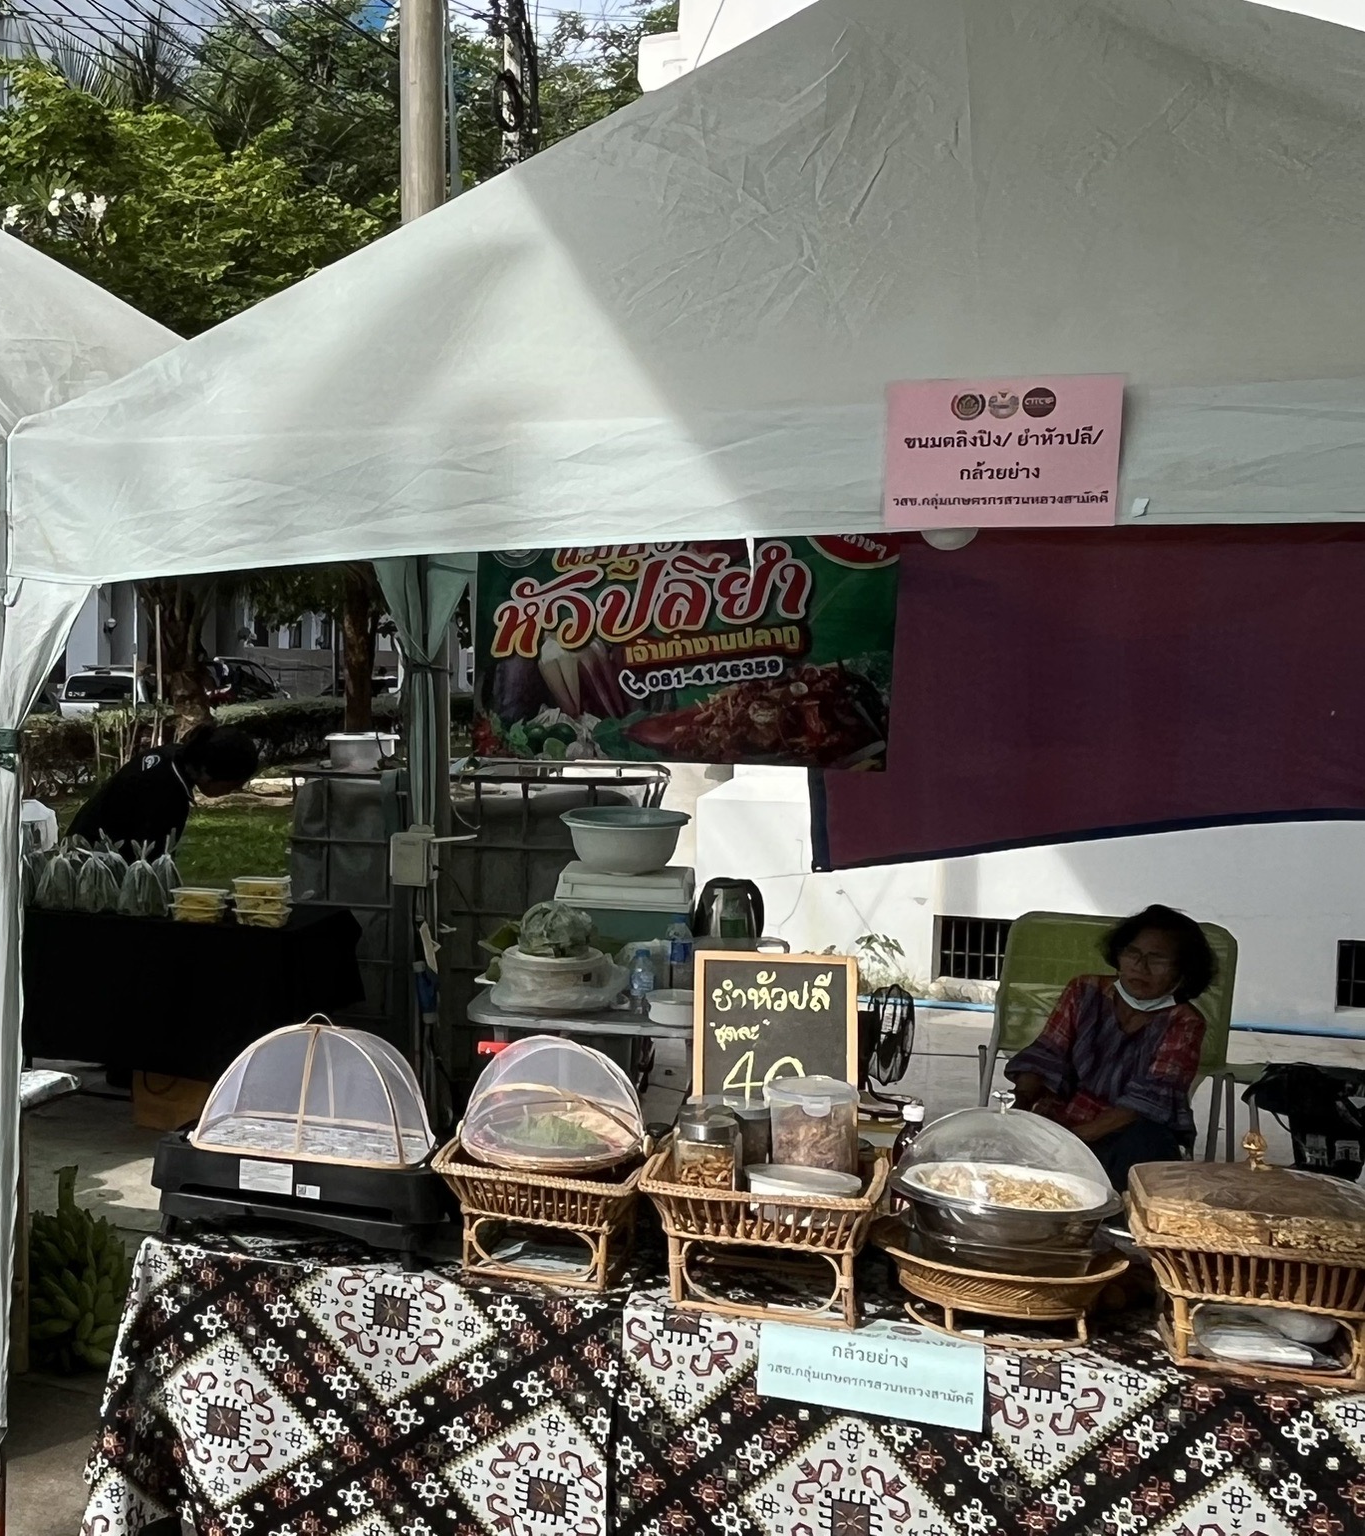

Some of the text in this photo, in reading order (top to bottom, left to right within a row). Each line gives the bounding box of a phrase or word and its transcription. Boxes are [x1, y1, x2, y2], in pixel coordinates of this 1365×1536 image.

[959, 461, 1041, 481] กล้วยย่าง
[493, 541, 810, 657] หัวปลียำ
[648, 658, 781, 690] 081-4146359
[712, 970, 833, 1012] ยำหัวปลี
[831, 1341, 910, 1369] กล้วยย่าง
